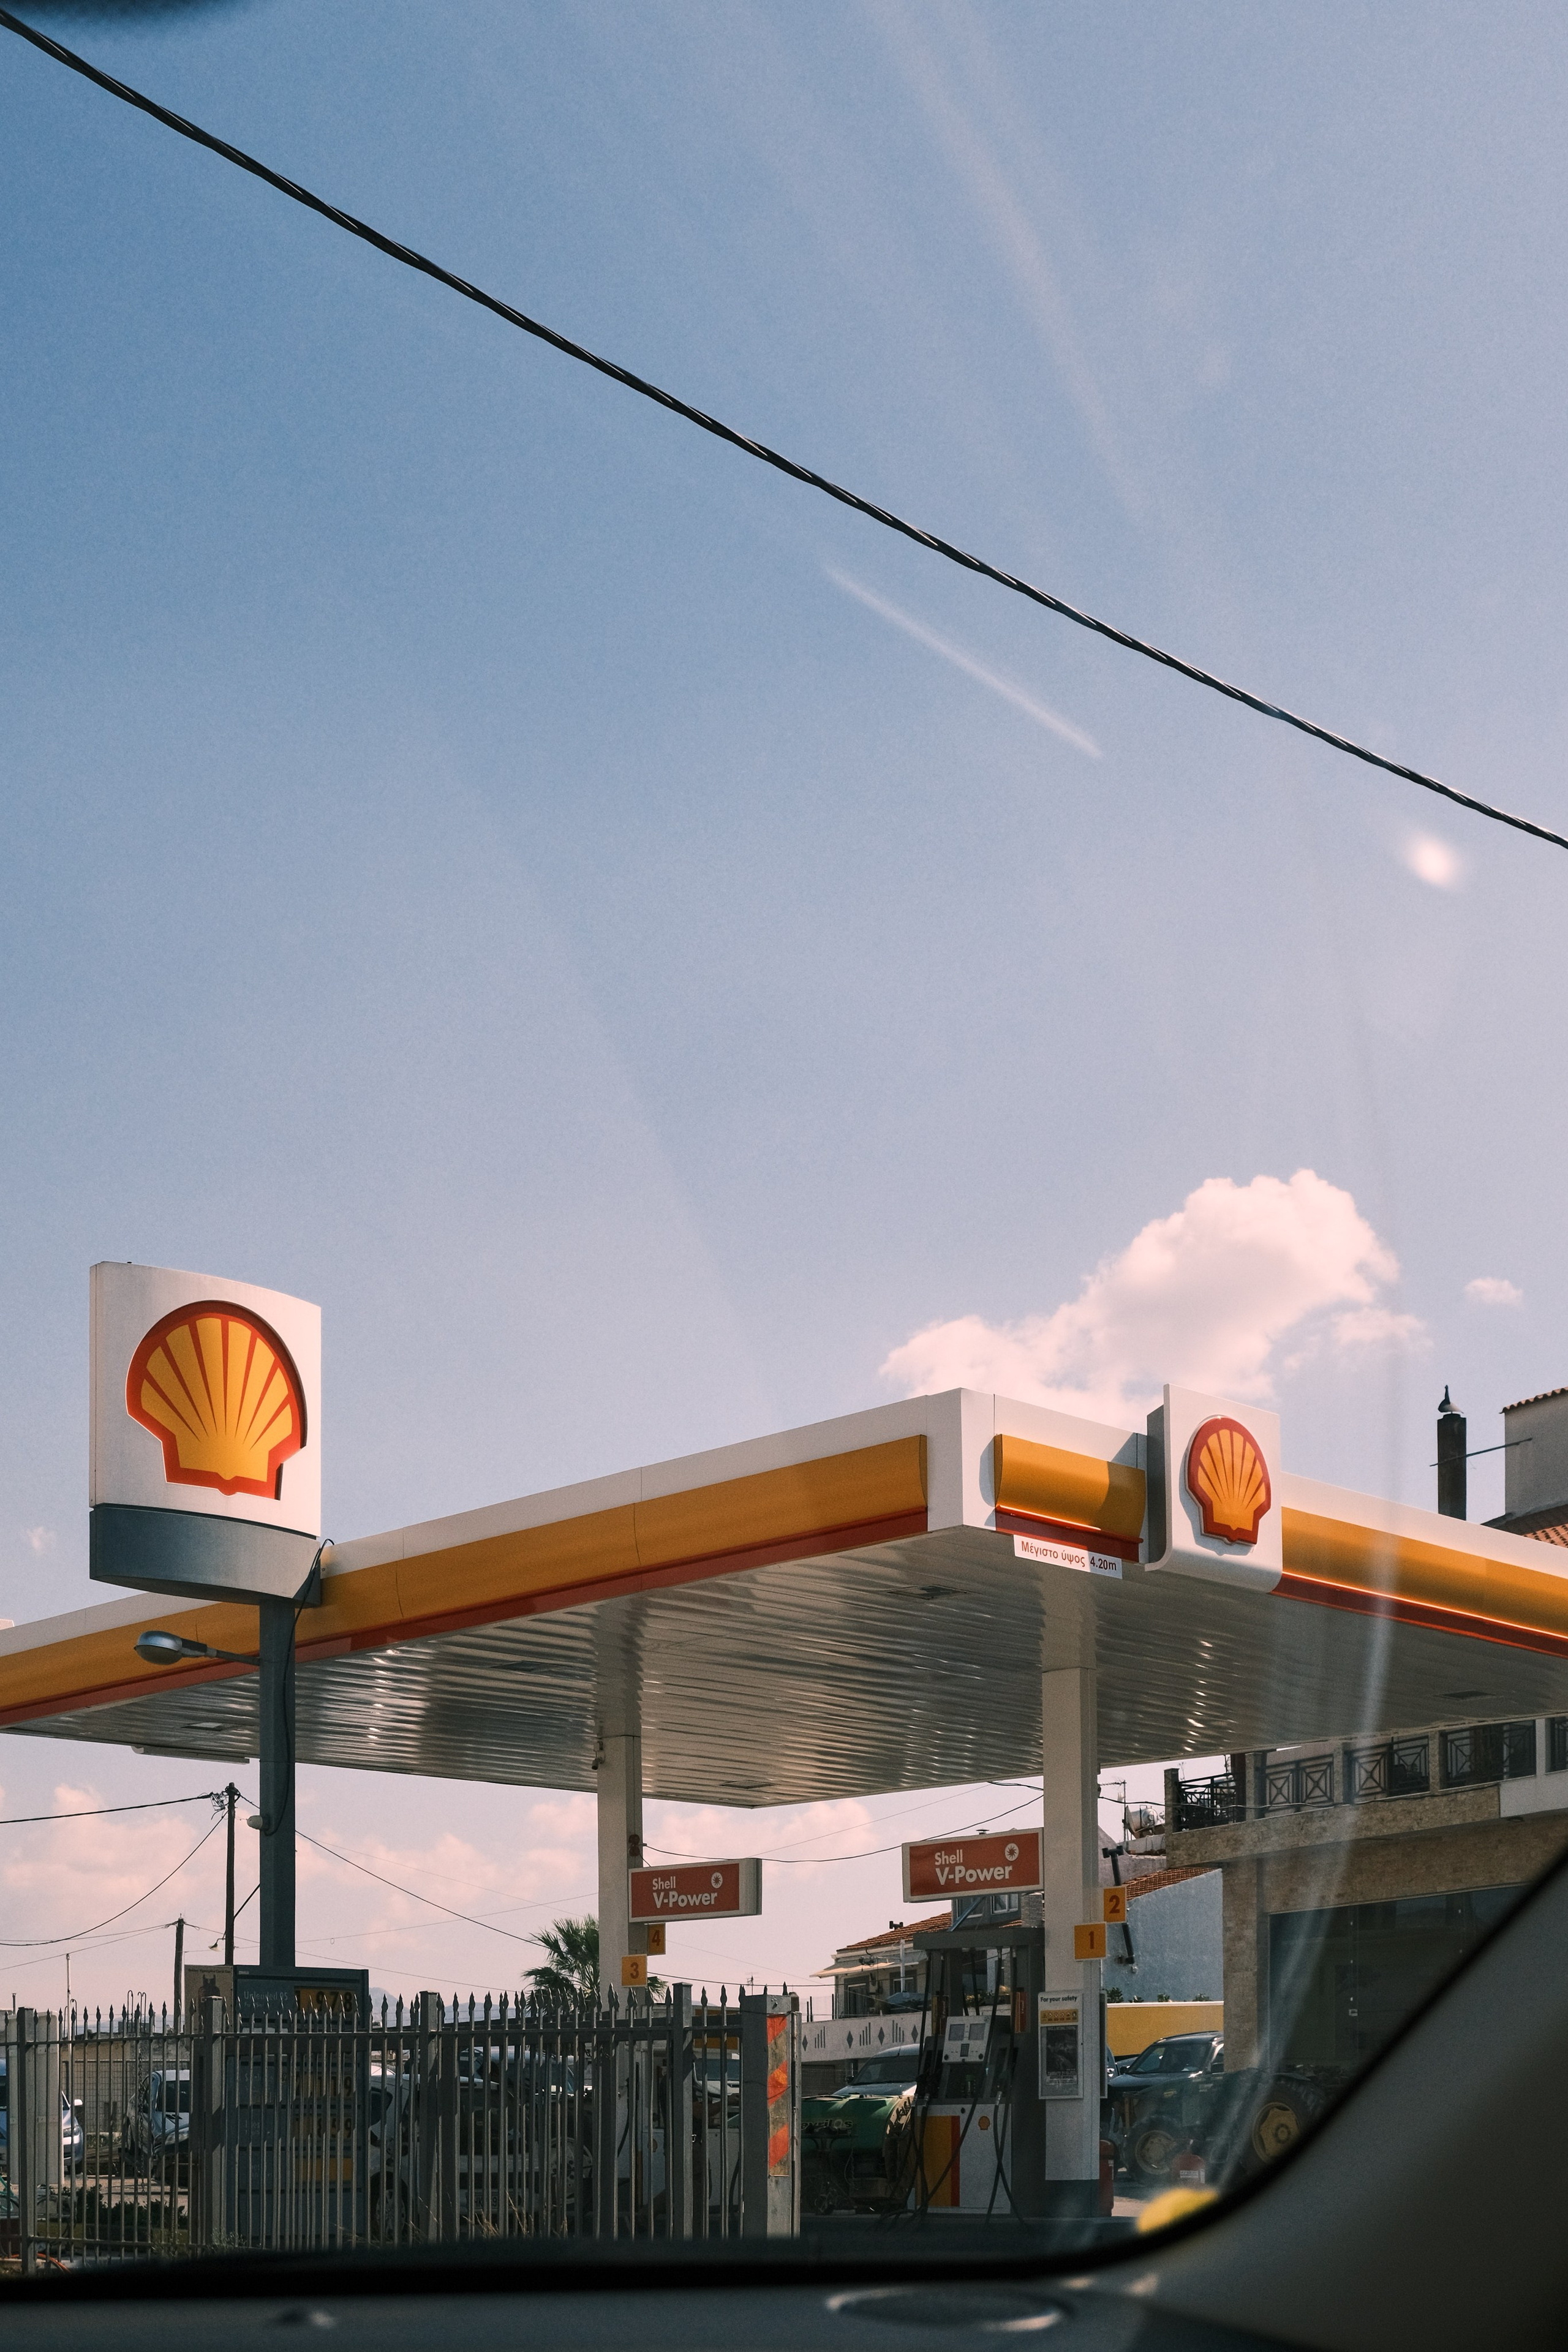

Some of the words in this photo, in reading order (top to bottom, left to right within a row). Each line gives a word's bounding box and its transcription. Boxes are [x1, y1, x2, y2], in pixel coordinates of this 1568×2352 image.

[1021, 1541, 1058, 1559] Μέγιστο
[1061, 1550, 1085, 1567] ύψος
[1090, 1556, 1117, 1571] 4.20m
[935, 1849, 963, 1866] Shell
[652, 1876, 676, 1890] Shell
[935, 1865, 1012, 1885] V-Power
[652, 1891, 718, 1909] V-Power
[1109, 1894, 1120, 1914] 2
[652, 1929, 661, 1947] 4
[1088, 1931, 1095, 1949] 1
[630, 1962, 639, 1979] 3
